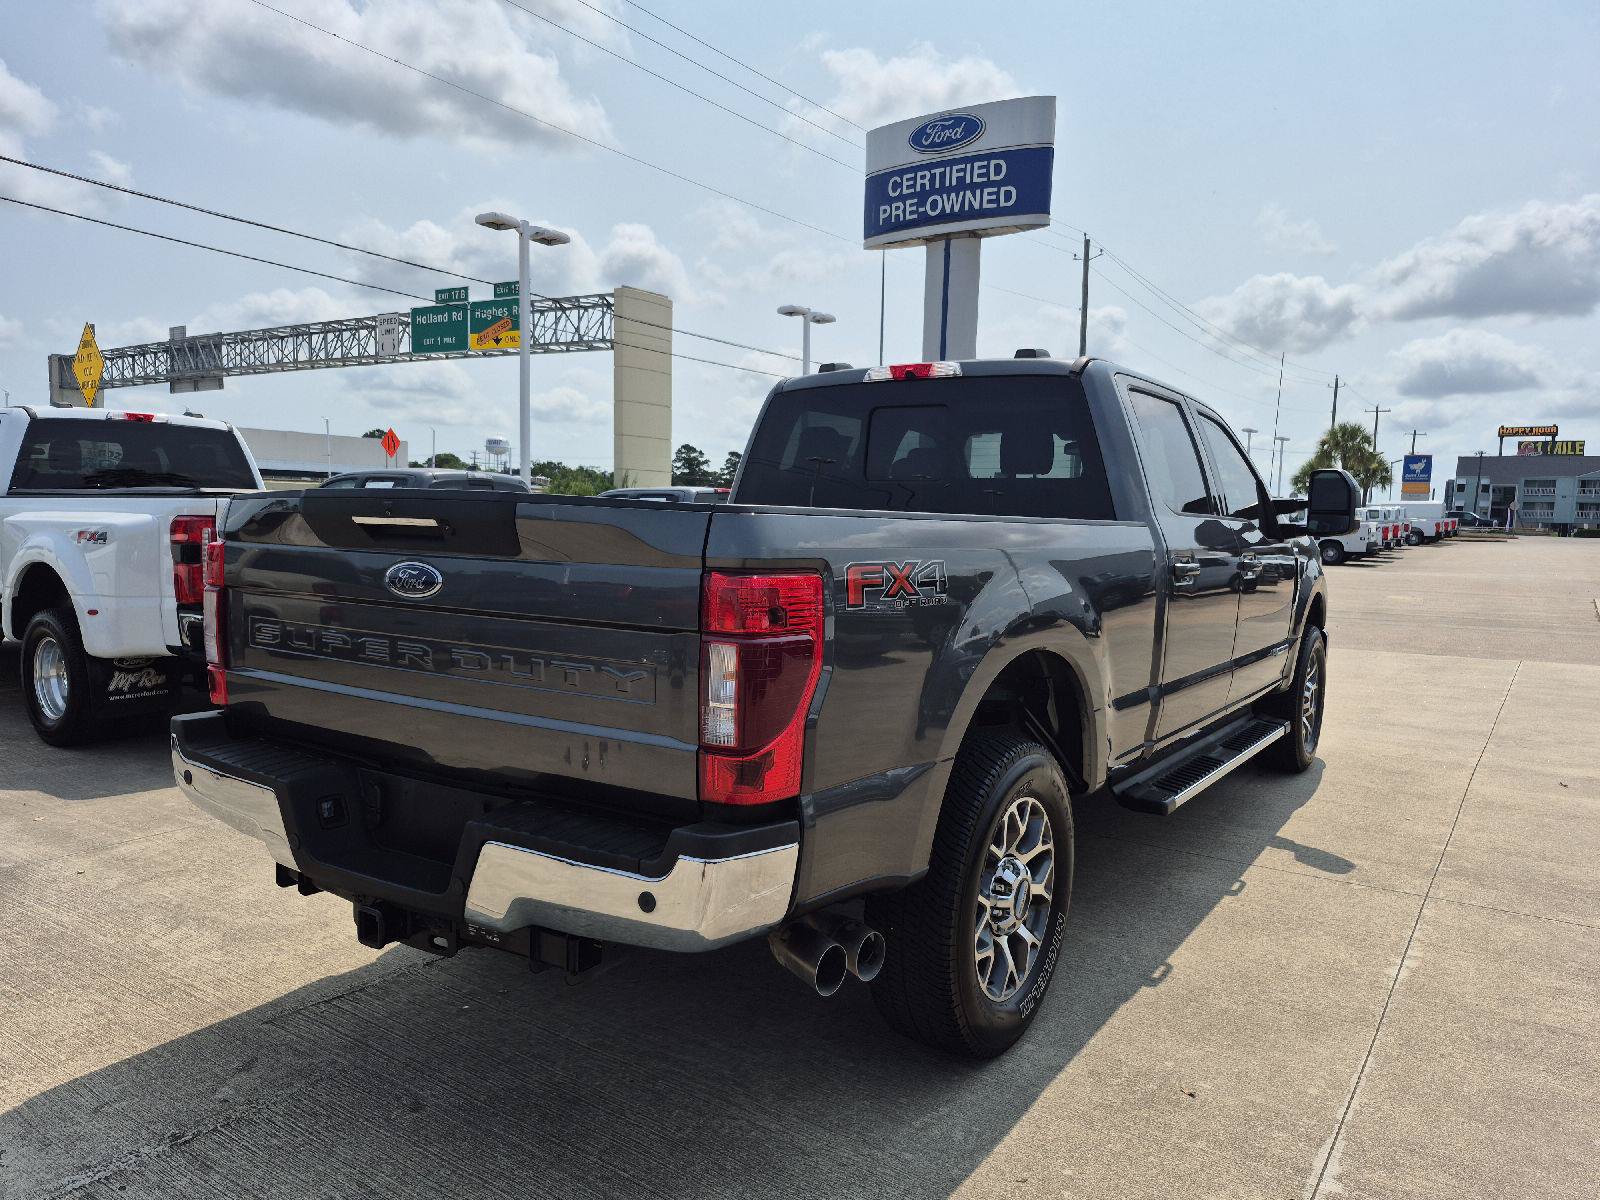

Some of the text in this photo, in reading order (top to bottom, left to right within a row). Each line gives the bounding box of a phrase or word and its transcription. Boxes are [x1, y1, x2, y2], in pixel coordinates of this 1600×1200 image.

[922, 119, 966, 145] Ford
[888, 159, 1007, 197] CERTIFIED
[879, 185, 1017, 226] PRE-OWNED
[438, 293, 449, 301] EXIT
[496, 285, 508, 294] EXIT
[416, 310, 463, 325] Holland Rd
[475, 306, 508, 321] Hughes
[379, 317, 398, 326] SPEED
[380, 328, 396, 336] LIMIT
[423, 337, 434, 346] EXIT
[443, 336, 456, 345] MILE
[1500, 426, 1557, 435] HAPPY HOUR
[77, 530, 108, 545] FX4
[396, 569, 427, 589] Ford
[844, 560, 949, 610] FX4
[895, 596, 947, 609] OFF ROAD
[254, 621, 649, 693] SUPER DUTY
